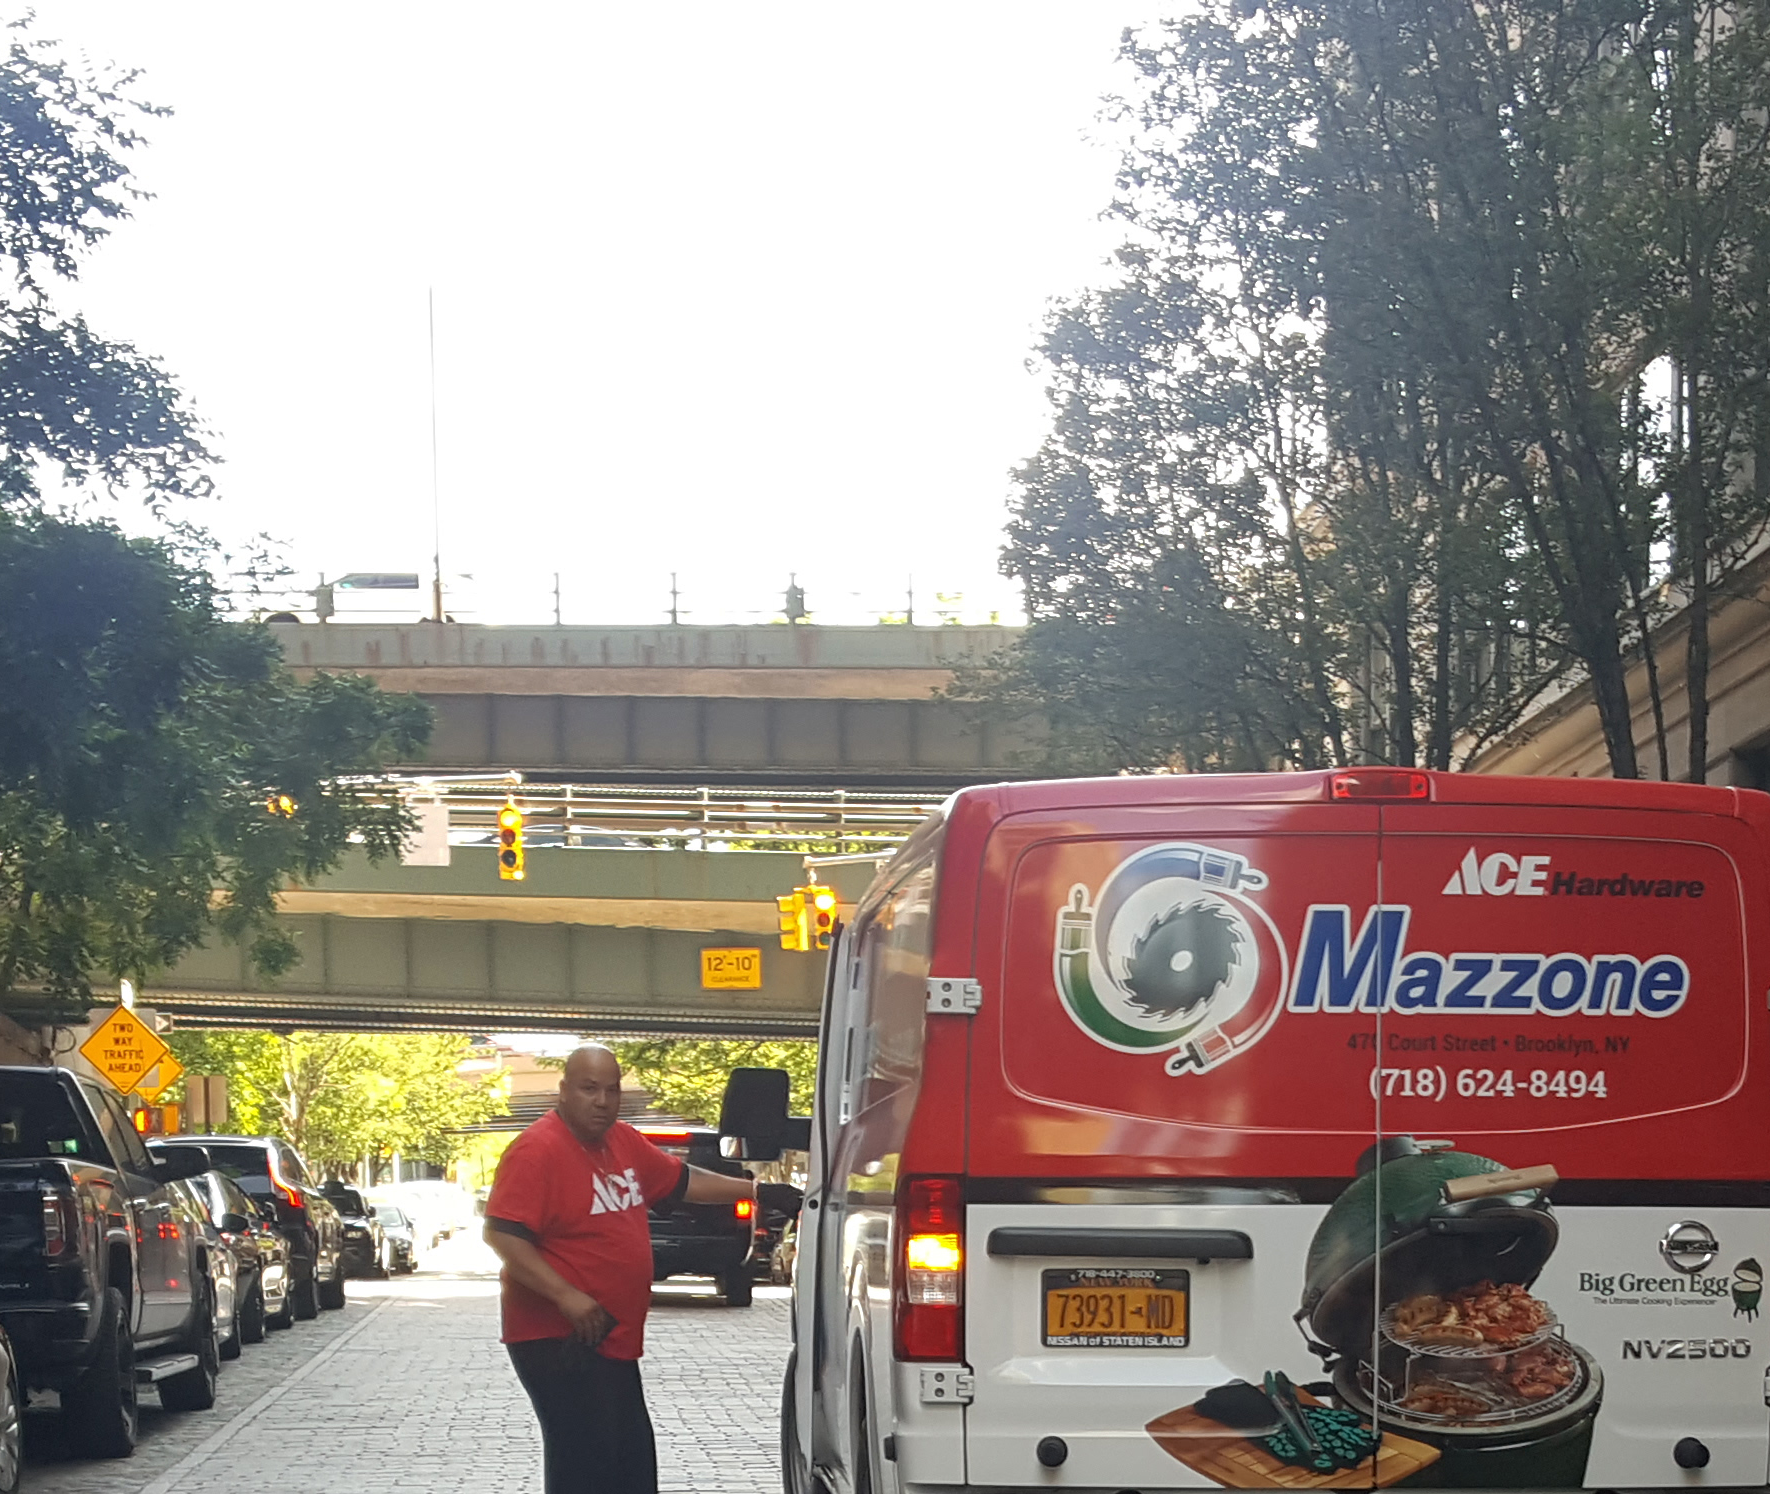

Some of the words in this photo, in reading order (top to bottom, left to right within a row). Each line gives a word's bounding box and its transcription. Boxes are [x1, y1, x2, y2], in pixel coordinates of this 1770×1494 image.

[1441, 846, 1552, 896] ACE
[1552, 871, 1705, 898] Hardware
[1289, 906, 1689, 1017] Mazzone
[112, 1023, 134, 1033] TWO
[113, 1037, 134, 1046] WAY
[1388, 1033, 1437, 1052] Court
[1443, 1034, 1497, 1052] Street
[1514, 1035, 1599, 1058] Brooklyn,
[1605, 1036, 1632, 1054] NY
[103, 1049, 144, 1060] TRAFFIC
[108, 1063, 142, 1073] AHEAD
[1369, 1065, 1447, 1102] (718)
[1455, 1068, 1608, 1098] 624-8494
[589, 1168, 644, 1215] ACE
[1579, 1273, 1615, 1296] Big
[1619, 1273, 1685, 1292] Green
[1690, 1273, 1730, 1297] Egg
[1593, 1296, 1608, 1305] The
[1047, 1336, 1087, 1346] NISSAN
[1089, 1336, 1100, 1346] of
[1102, 1336, 1143, 1346] STATEN
[1144, 1336, 1185, 1346] ISLAND
[1622, 1338, 1752, 1360] NV2500
